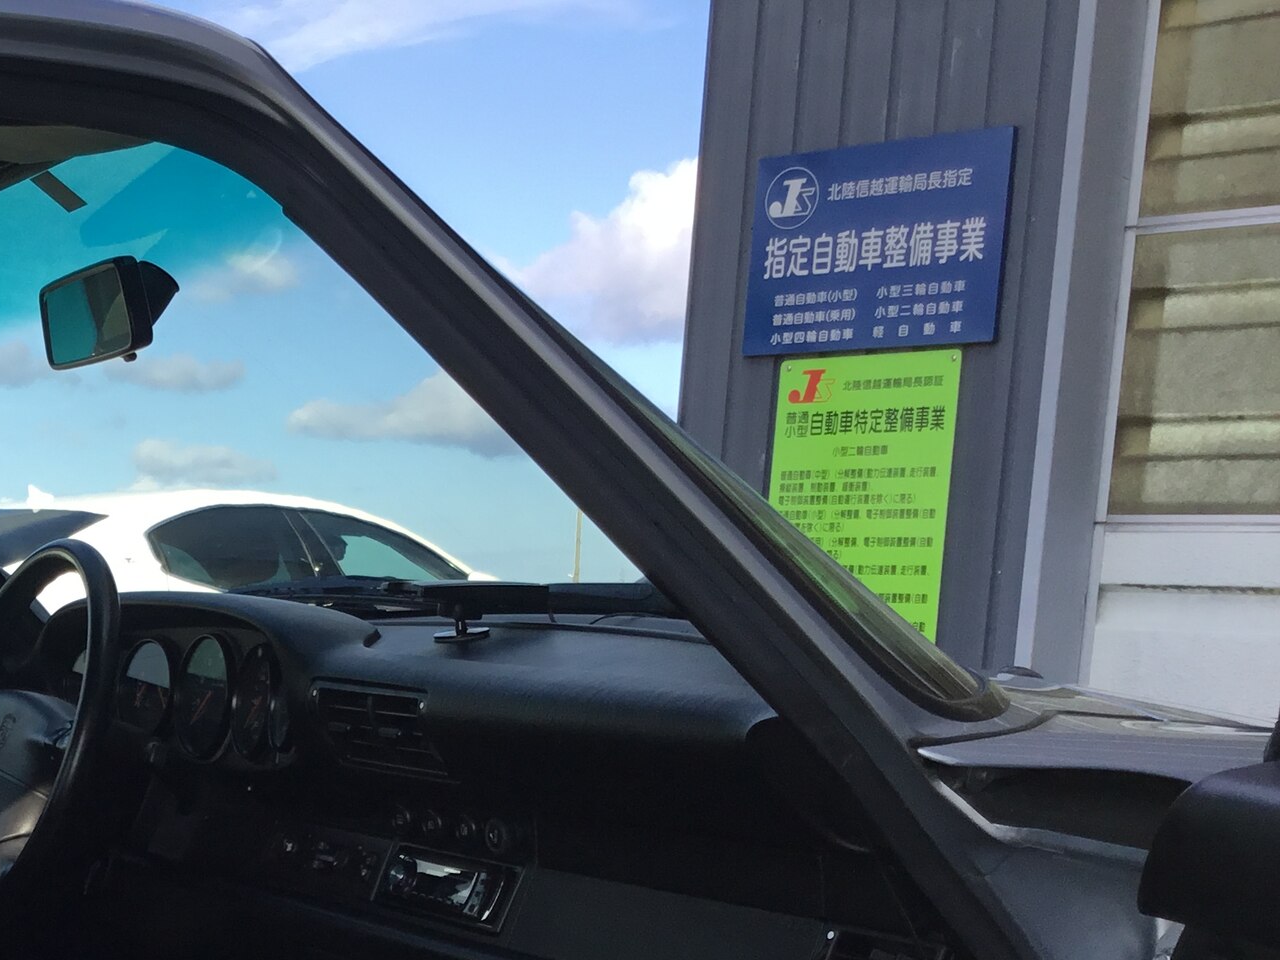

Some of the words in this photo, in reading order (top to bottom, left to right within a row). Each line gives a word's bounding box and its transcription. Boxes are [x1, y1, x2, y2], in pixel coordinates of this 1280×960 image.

[827, 168, 974, 202] 北陸信越運輸局長指定
[763, 217, 987, 280] 指定自動車整備事業
[876, 280, 967, 300] 小型三輪自動車
[874, 301, 964, 319] 小型二輪自動車
[810, 405, 946, 437] 自動車特定整備事業
